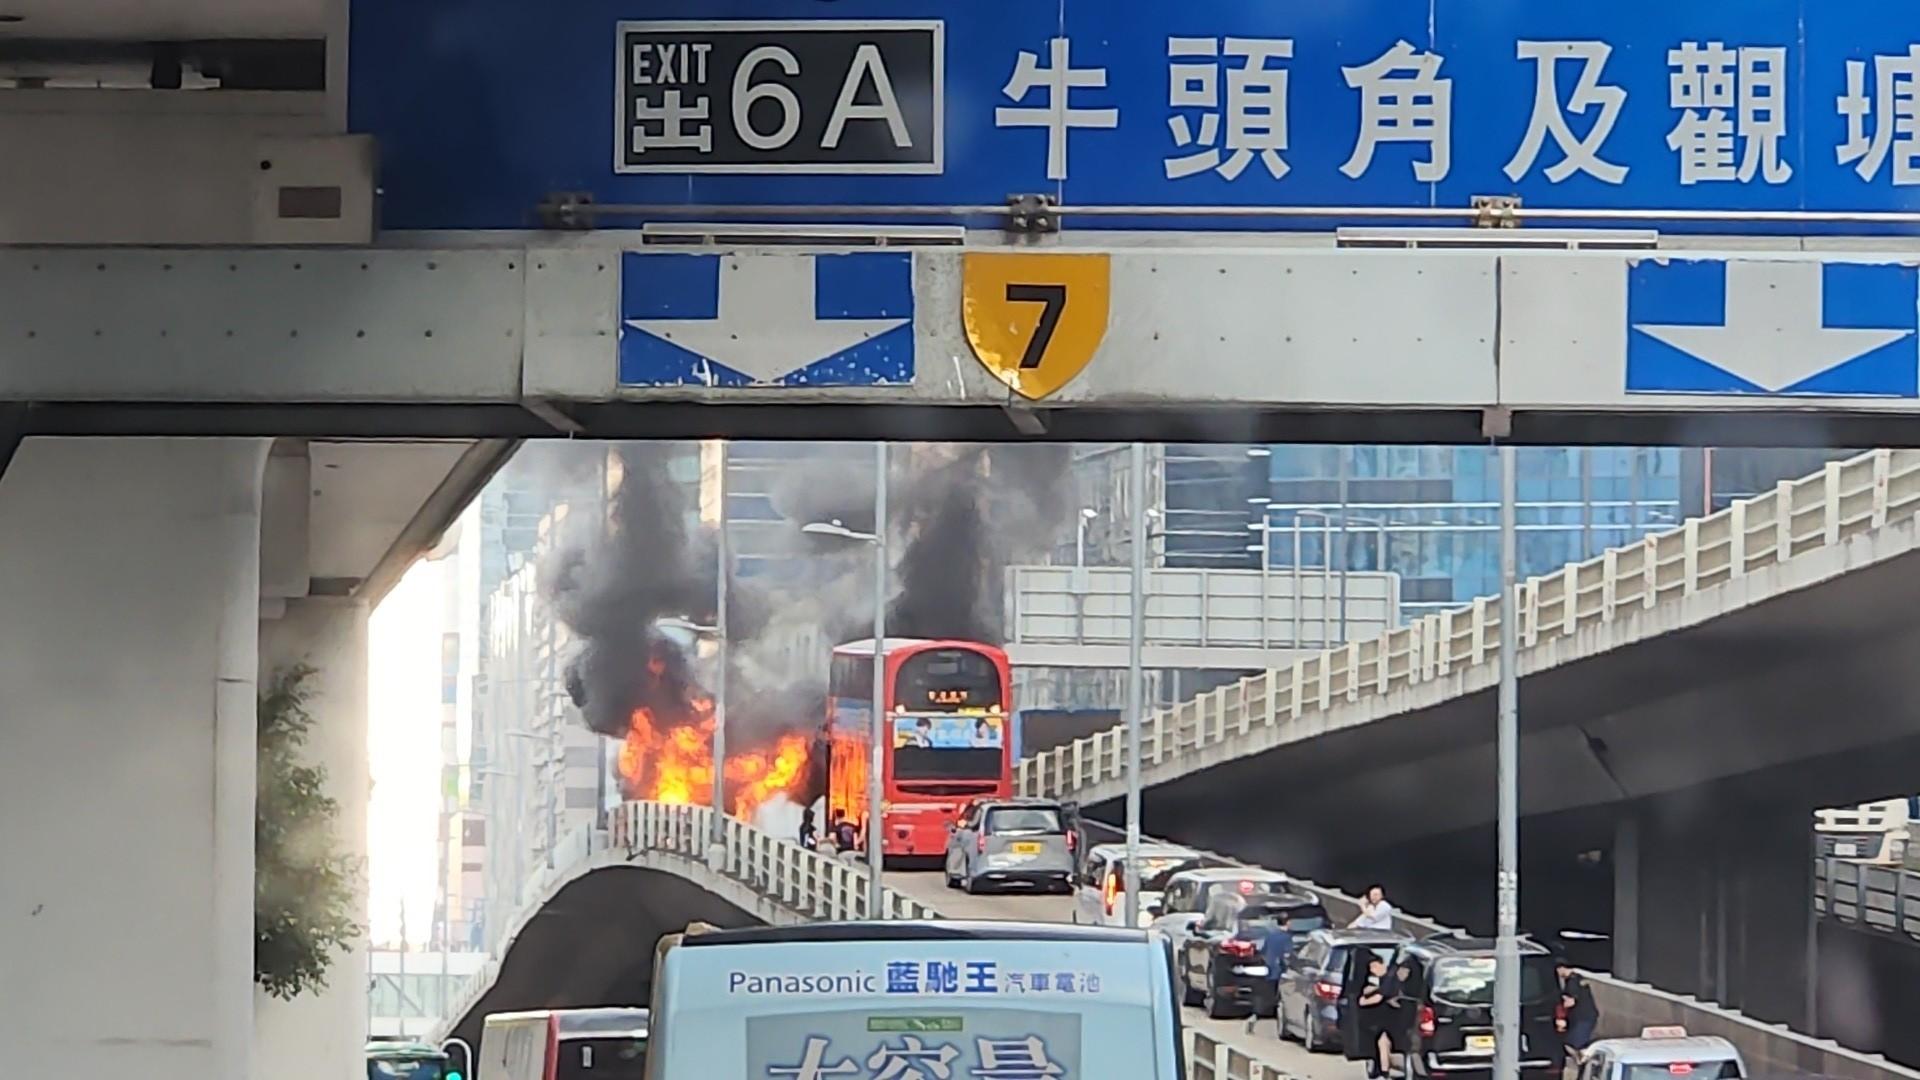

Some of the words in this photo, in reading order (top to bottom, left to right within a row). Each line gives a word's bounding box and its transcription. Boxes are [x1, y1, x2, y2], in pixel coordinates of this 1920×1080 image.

[632, 44, 713, 85] EXIT
[731, 44, 913, 150] 6A
[632, 89, 712, 154] 出
[1006, 284, 1067, 369] 7
[729, 969, 876, 993] Panasonic
[886, 961, 998, 993] 藍馳王
[1004, 972, 1100, 993] 汽車電池
